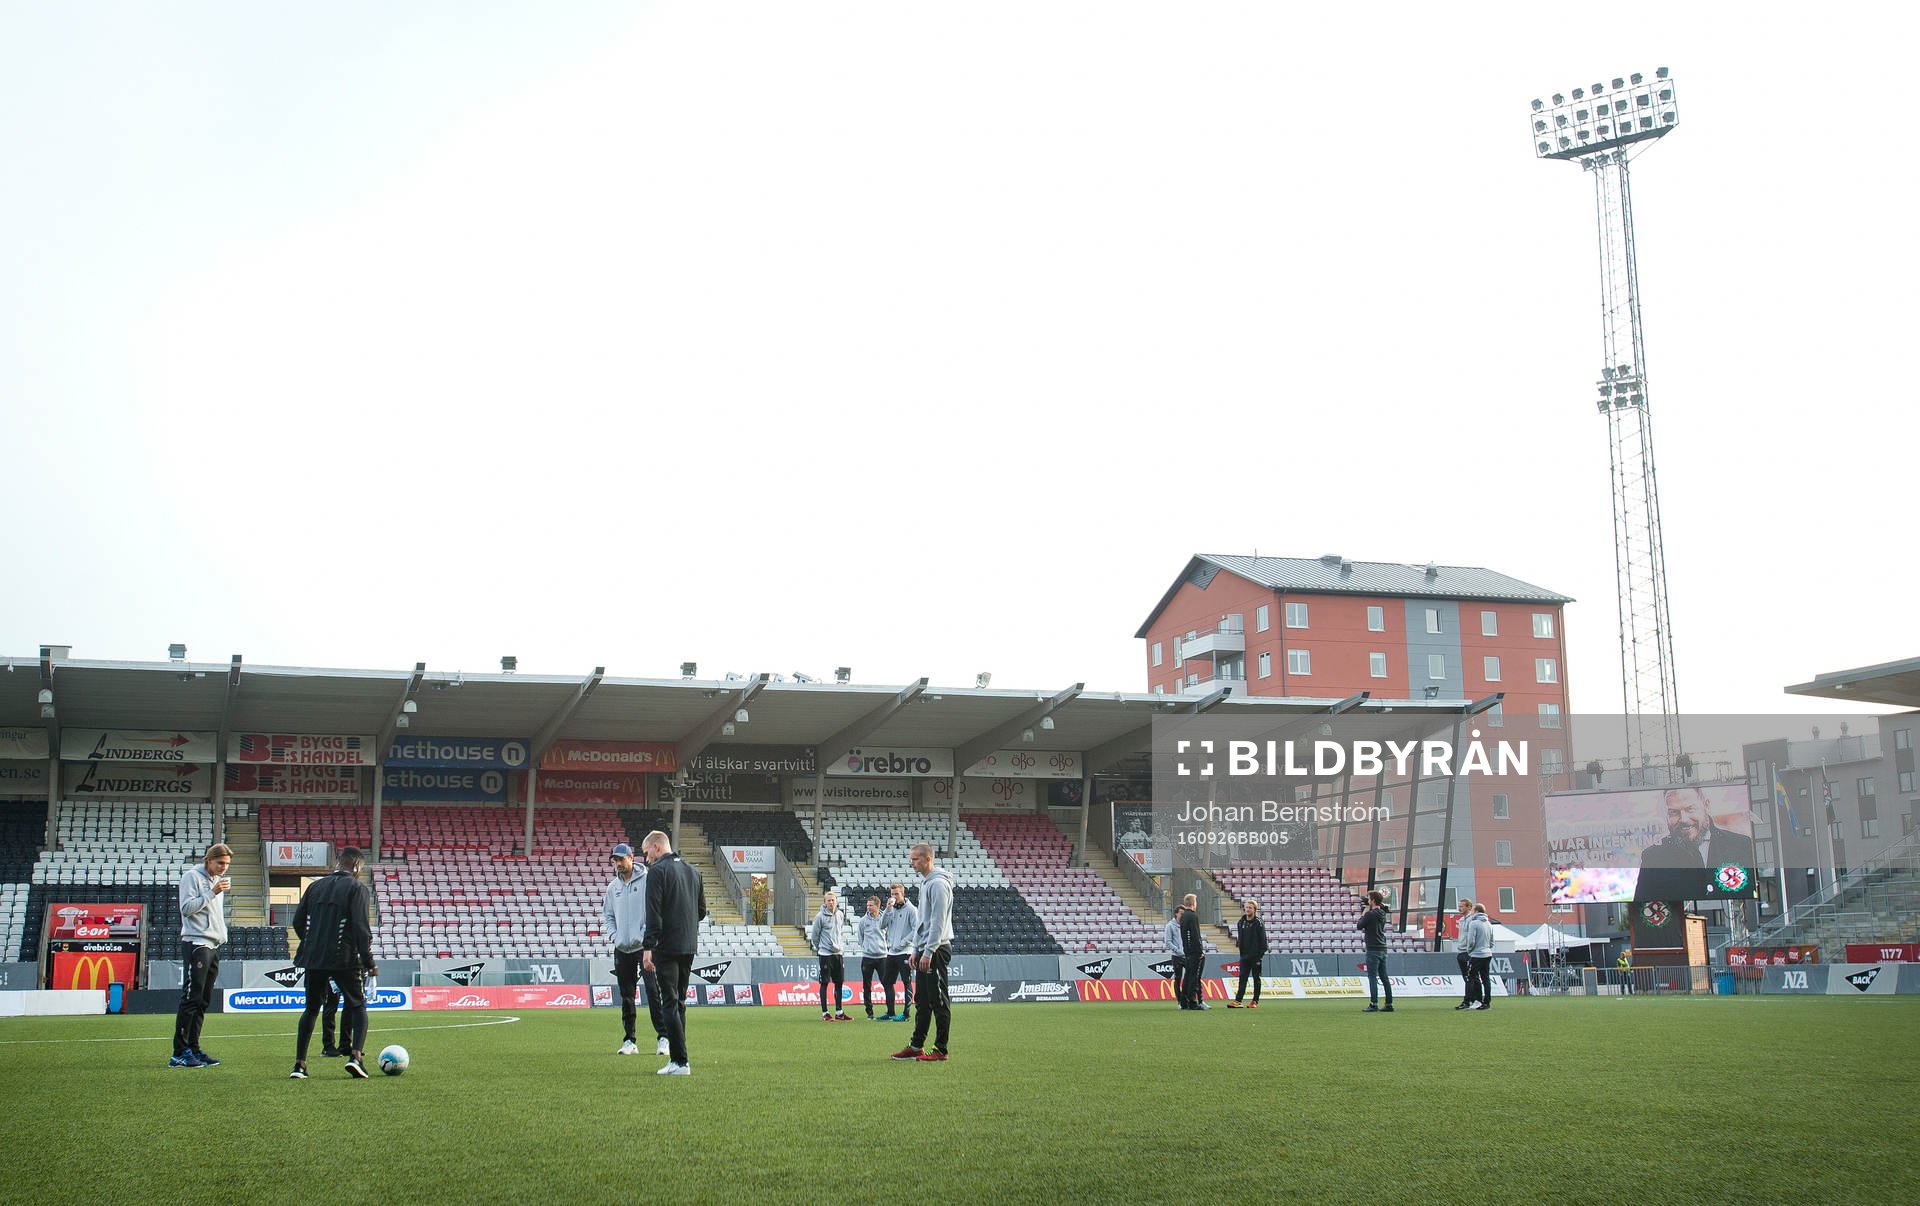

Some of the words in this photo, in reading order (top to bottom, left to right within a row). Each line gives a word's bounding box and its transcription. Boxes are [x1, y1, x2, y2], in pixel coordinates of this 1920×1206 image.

[88, 733, 184, 760] LINDBERGS
[301, 737, 343, 749] BYGG
[389, 741, 495, 761] nethouse
[567, 751, 653, 763] McDonald's
[300, 751, 363, 764] HANDEL
[848, 749, 932, 774] örebro
[706, 757, 750, 770] älskar
[753, 758, 816, 771] svartvitt!
[291, 765, 336, 777] BYGG
[75, 762, 193, 793] LINDBERGS
[290, 779, 358, 793] HANDEL
[544, 778, 621, 790] McDonald's
[1880, 948, 1903, 960] 1177
[780, 965, 794, 978] Vi
[1085, 965, 1103, 974] BACK
[1291, 958, 1320, 975] NA
[1489, 957, 1515, 974] NA
[274, 972, 298, 981] BACK
[530, 964, 565, 983] NA
[700, 969, 721, 978] BACK
[1417, 976, 1453, 986] ICON
[1782, 971, 1809, 989] NA
[1852, 976, 1871, 985] BACK
[235, 994, 279, 1005] Mercuri
[448, 995, 491, 1007] Linde
[546, 994, 587, 1006] Linde
